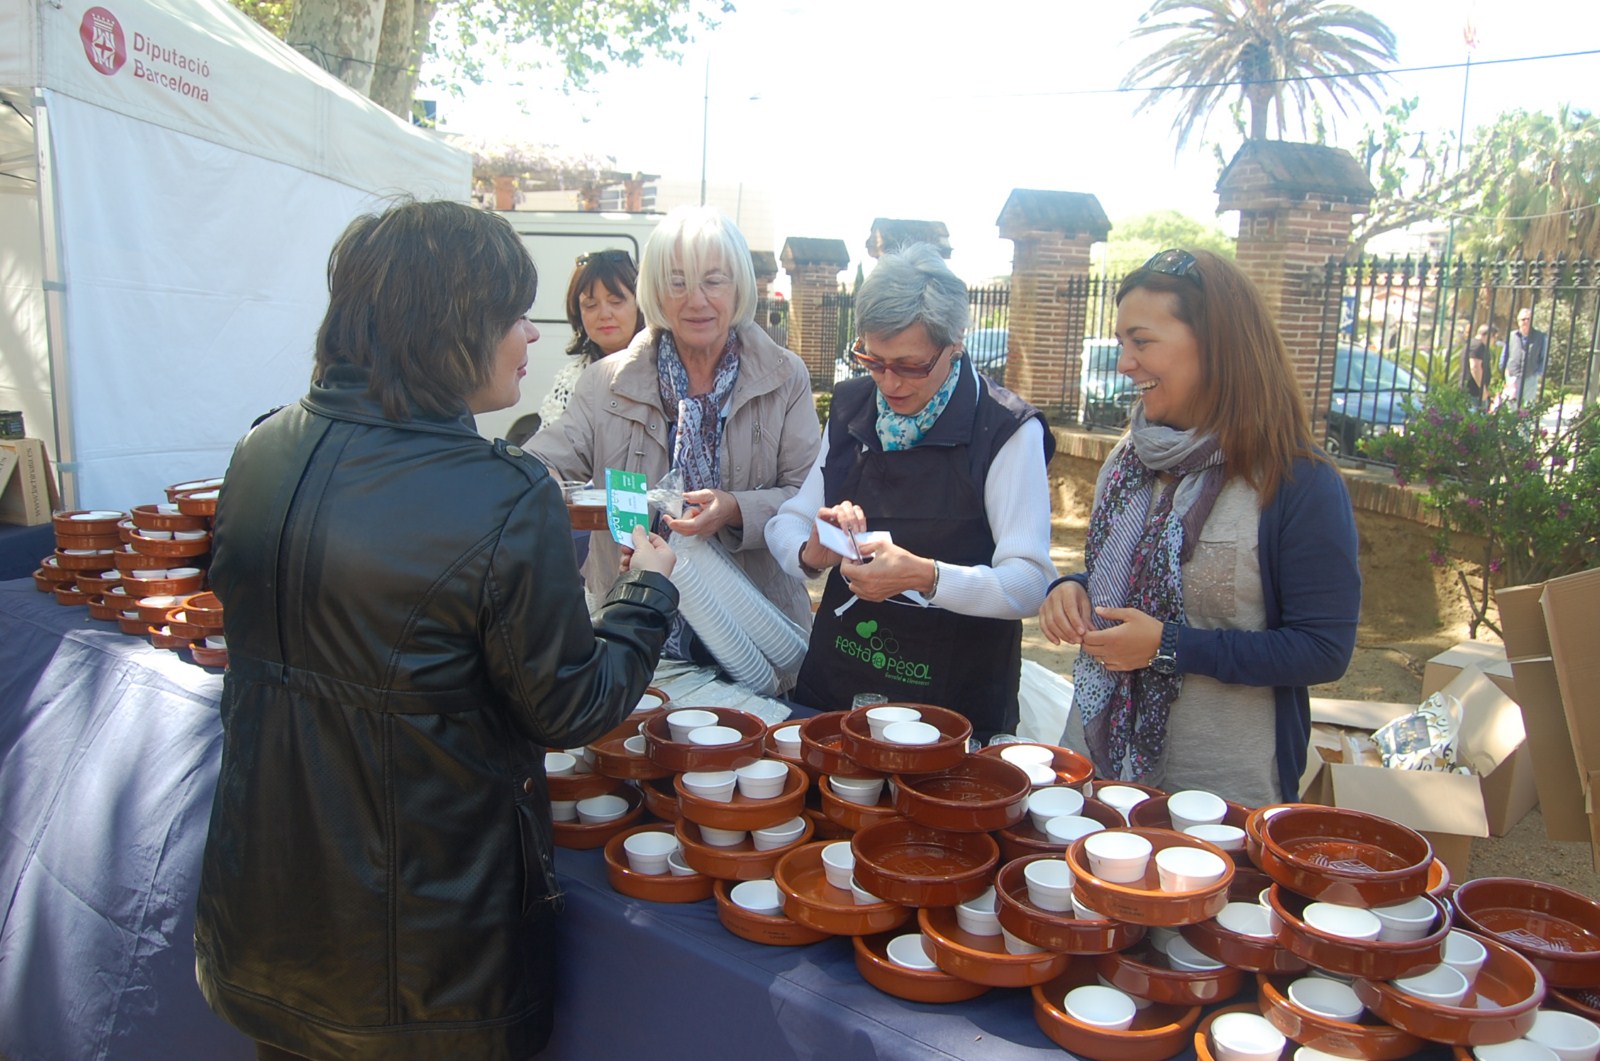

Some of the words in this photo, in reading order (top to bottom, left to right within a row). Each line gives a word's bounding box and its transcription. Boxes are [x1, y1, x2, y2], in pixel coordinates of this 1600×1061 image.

[133, 31, 210, 78] Diputació
[133, 58, 209, 102] Barcelona
[835, 635, 872, 662] festa
